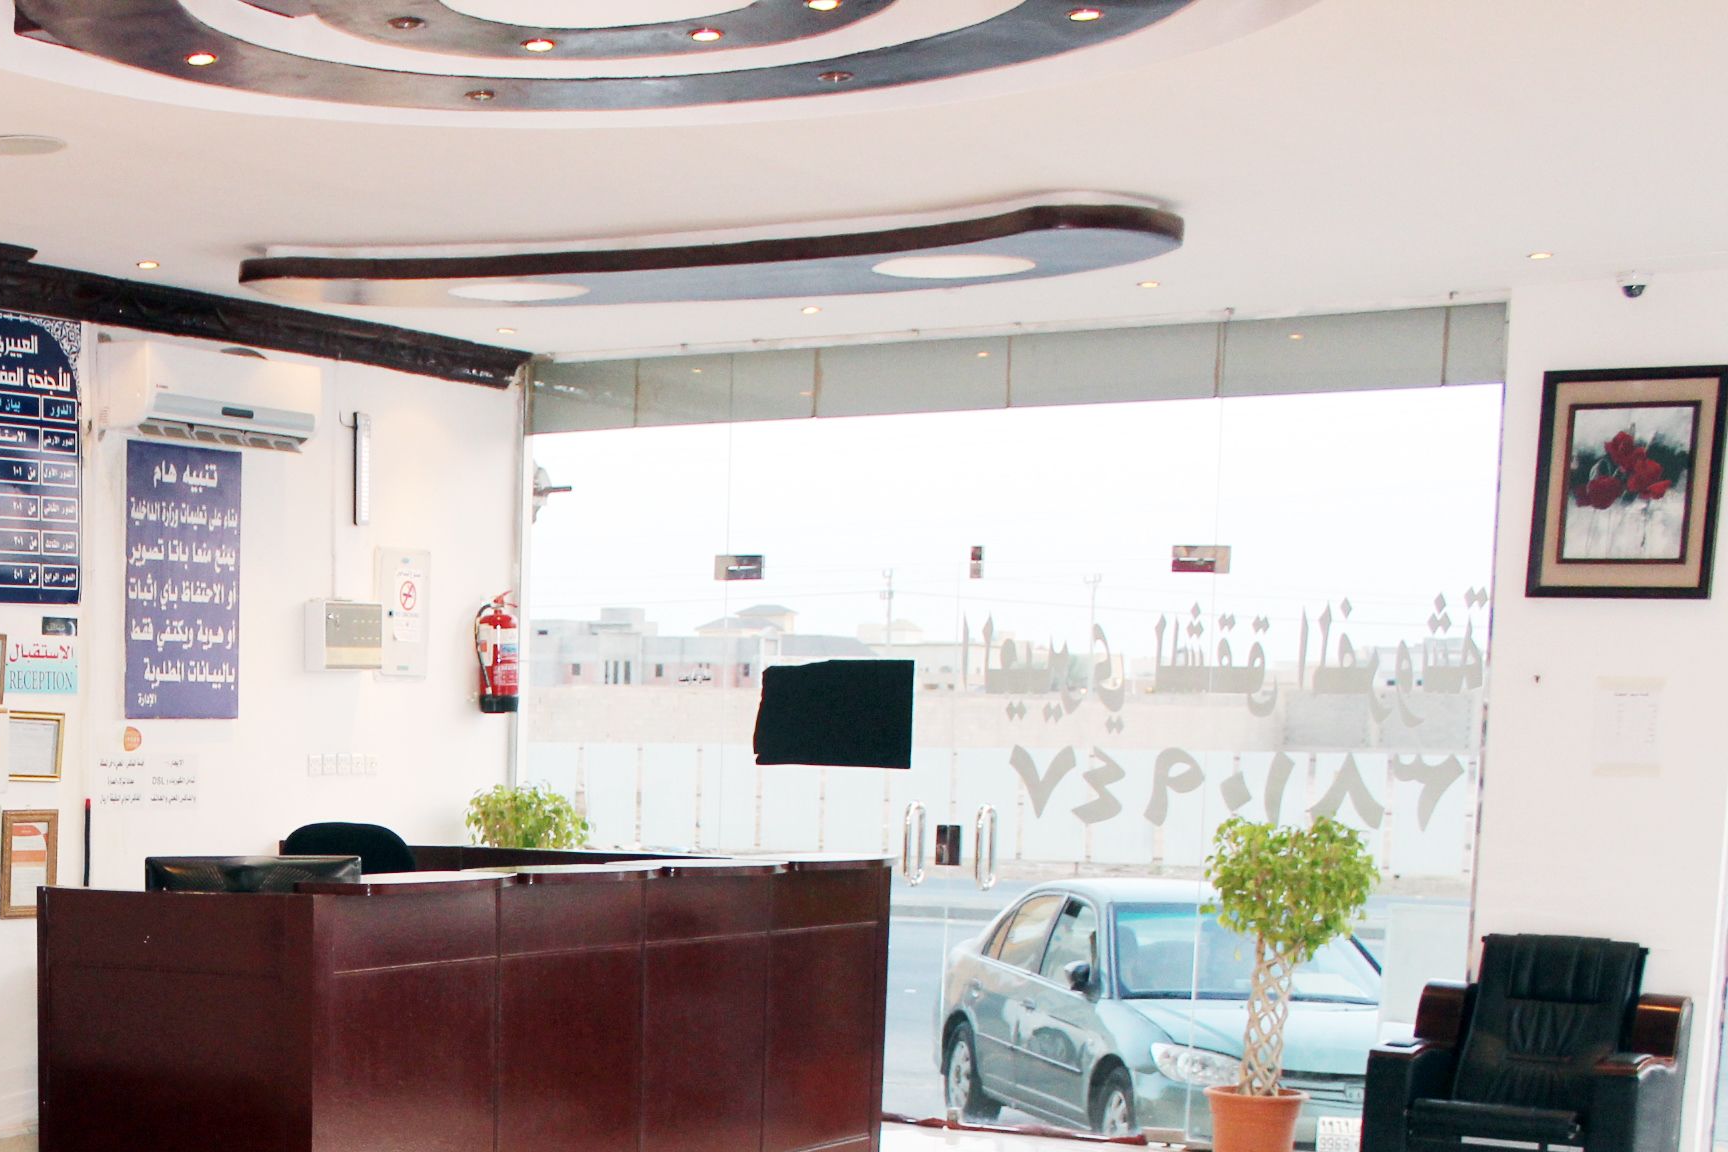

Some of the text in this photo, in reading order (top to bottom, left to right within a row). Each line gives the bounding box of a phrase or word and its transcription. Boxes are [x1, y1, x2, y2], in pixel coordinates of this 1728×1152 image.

[27, 366, 71, 395] للأجنحة
[5, 398, 21, 412] بيان
[50, 403, 72, 417] الدور
[12, 465, 22, 476] ١٠١
[27, 466, 36, 480] من
[153, 460, 218, 493] تنبيه هام
[28, 502, 36, 516] من
[130, 496, 161, 526] الداخلية
[161, 501, 179, 528] وزارة
[180, 502, 208, 531] تعليمات
[208, 507, 222, 532] على
[29, 536, 38, 550] من
[128, 538, 165, 567] تصوير
[214, 544, 236, 574] يمنع
[13, 568, 23, 580] ٤٠١
[28, 568, 37, 584] من
[128, 573, 157, 607] إثبات
[160, 578, 178, 611] بأي
[181, 580, 224, 604] الاحتفاظ
[131, 617, 154, 641] فقط
[156, 619, 194, 652] ويكتفي
[197, 619, 224, 650] هوية
[9, 670, 73, 690] RECEPTION
[144, 657, 235, 690] بالبيانات المطلوبة
